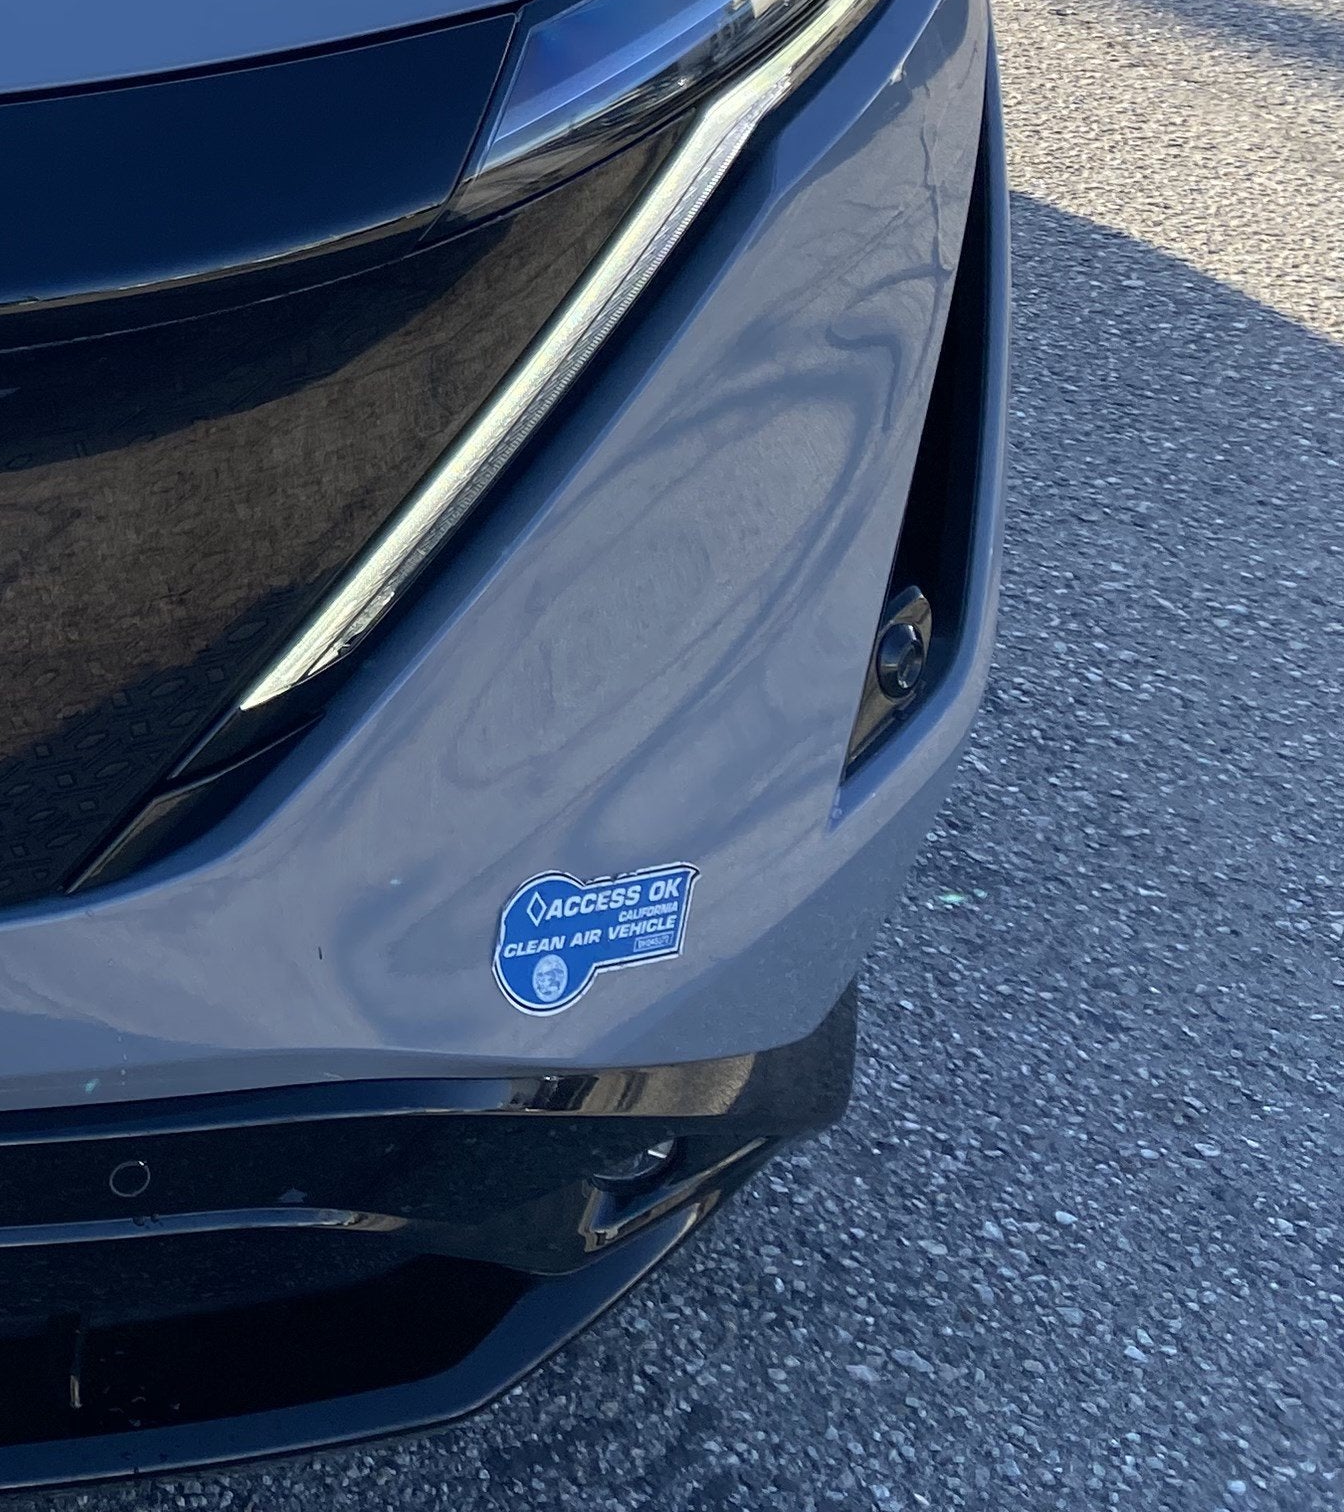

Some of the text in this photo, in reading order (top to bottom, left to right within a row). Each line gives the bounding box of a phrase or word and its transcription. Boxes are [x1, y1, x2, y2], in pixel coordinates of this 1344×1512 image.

[545, 876, 683, 921] ACCESS OK
[618, 900, 679, 922] CALIFORNIA
[503, 935, 566, 959] CLEAN
[569, 928, 603, 948] AIR
[608, 914, 678, 941] VEHICLE
